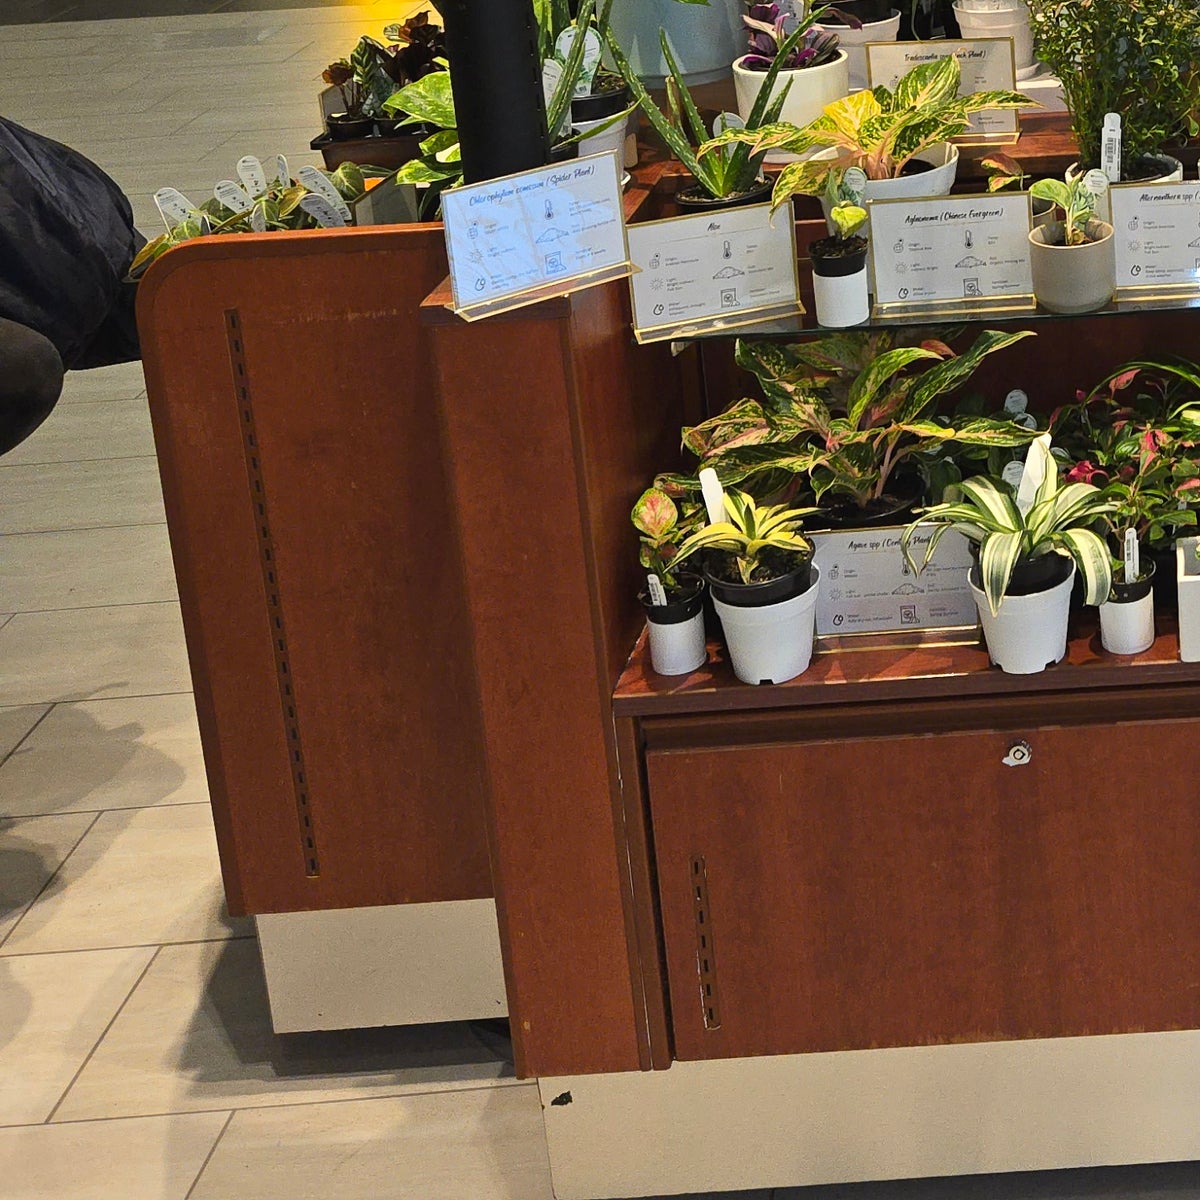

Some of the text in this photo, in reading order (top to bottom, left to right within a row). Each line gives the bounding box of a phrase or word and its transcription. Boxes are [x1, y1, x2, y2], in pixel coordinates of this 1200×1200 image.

[546, 173, 572, 187] (Spider
[574, 165, 596, 179] Plant)
[940, 211, 967, 223] (Chinese
[968, 207, 1004, 221] Evergreen)
[707, 222, 721, 232] Aloe
[848, 540, 868, 551] Agave
